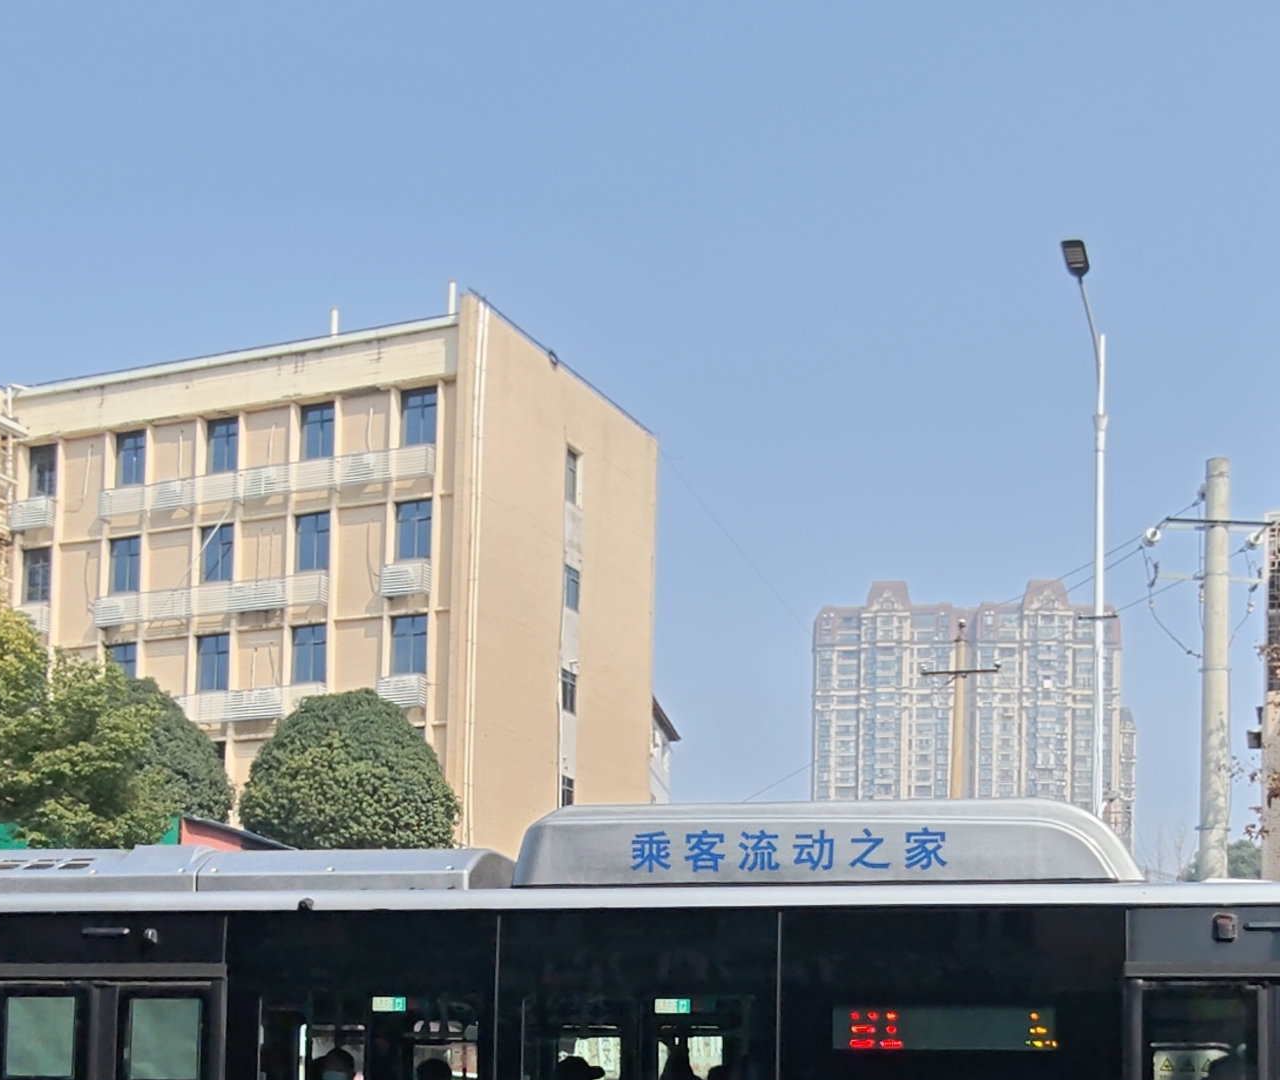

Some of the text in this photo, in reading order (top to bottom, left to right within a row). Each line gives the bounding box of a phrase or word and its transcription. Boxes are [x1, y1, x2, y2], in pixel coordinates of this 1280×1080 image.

[631, 826, 948, 873] 乘客流动之家
